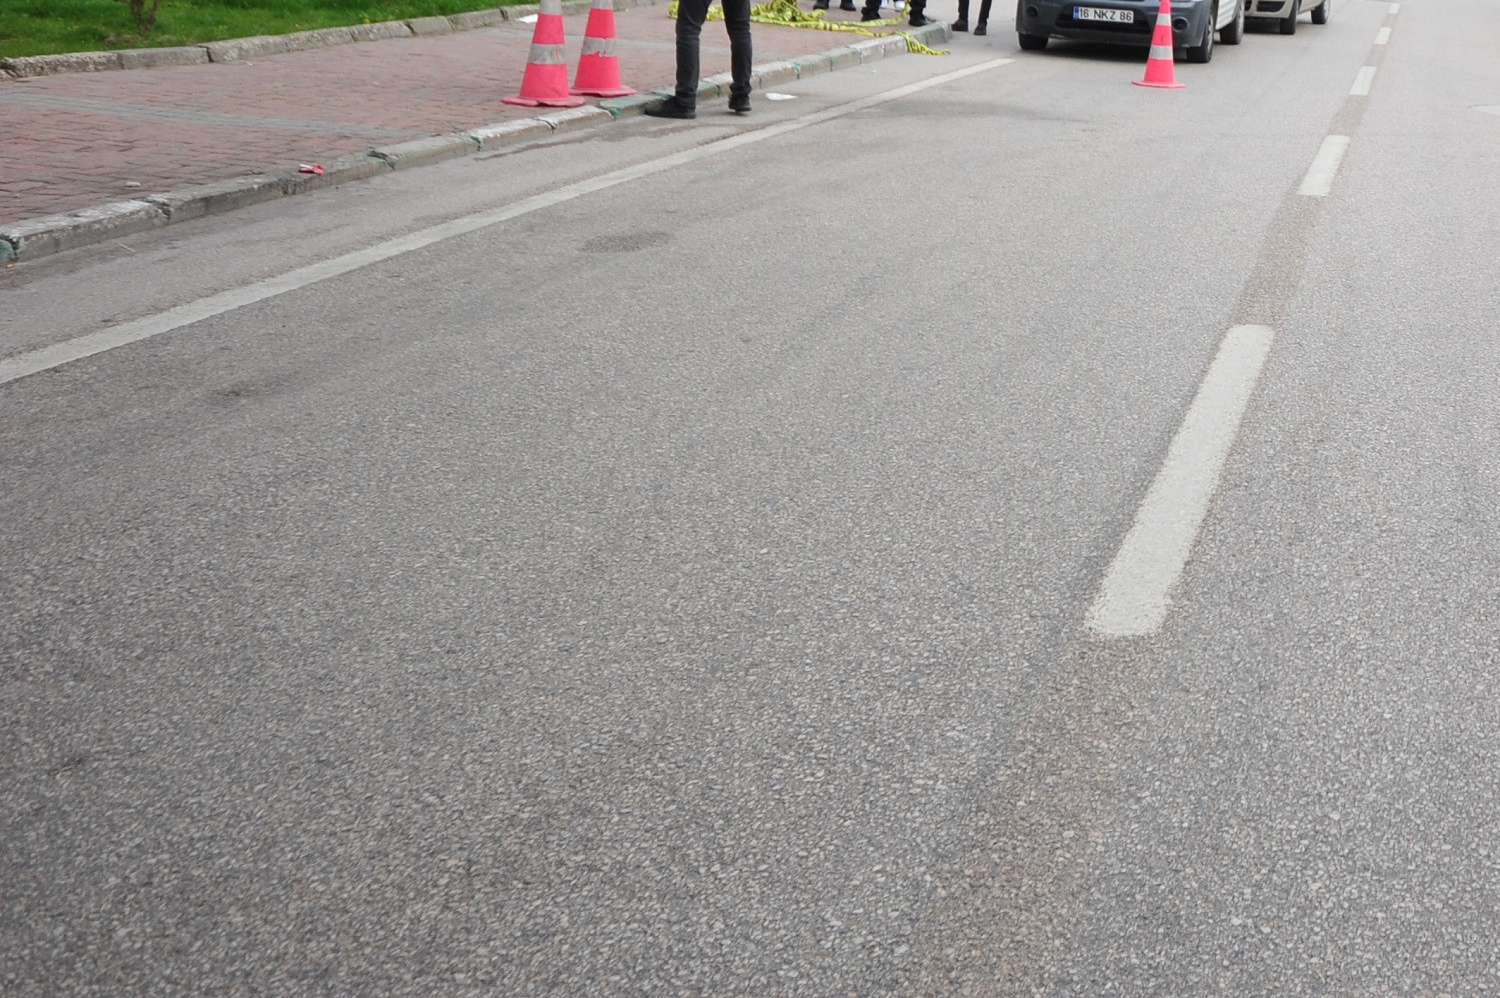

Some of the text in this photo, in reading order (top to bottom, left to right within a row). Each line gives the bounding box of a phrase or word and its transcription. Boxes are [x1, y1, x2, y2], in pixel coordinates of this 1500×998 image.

[1080, 7, 1132, 22] 16 NKZ 86
